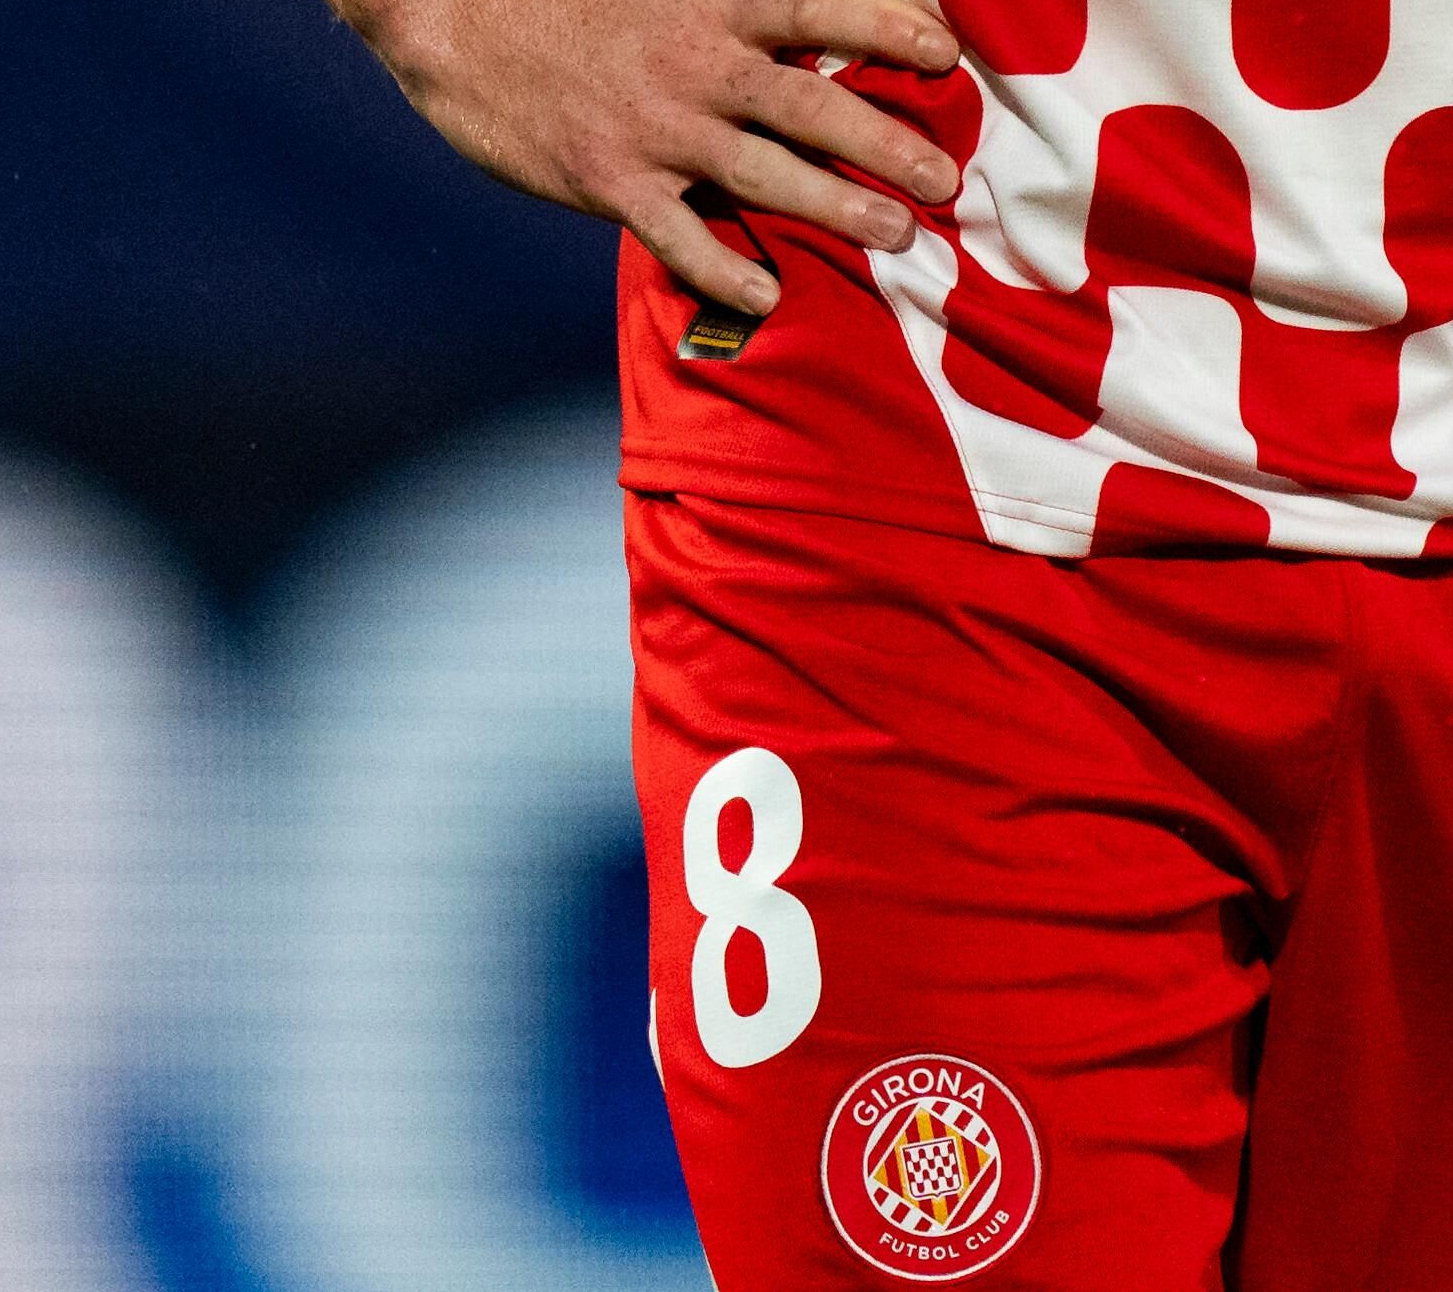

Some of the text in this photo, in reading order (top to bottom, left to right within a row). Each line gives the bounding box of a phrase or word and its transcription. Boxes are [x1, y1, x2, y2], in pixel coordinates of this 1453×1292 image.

[693, 325, 745, 341] FOOTBALL
[683, 746, 822, 1069] 8
[853, 1067, 985, 1127] GIRONA
[879, 1210, 1010, 1260] FUTBOL CLUB
